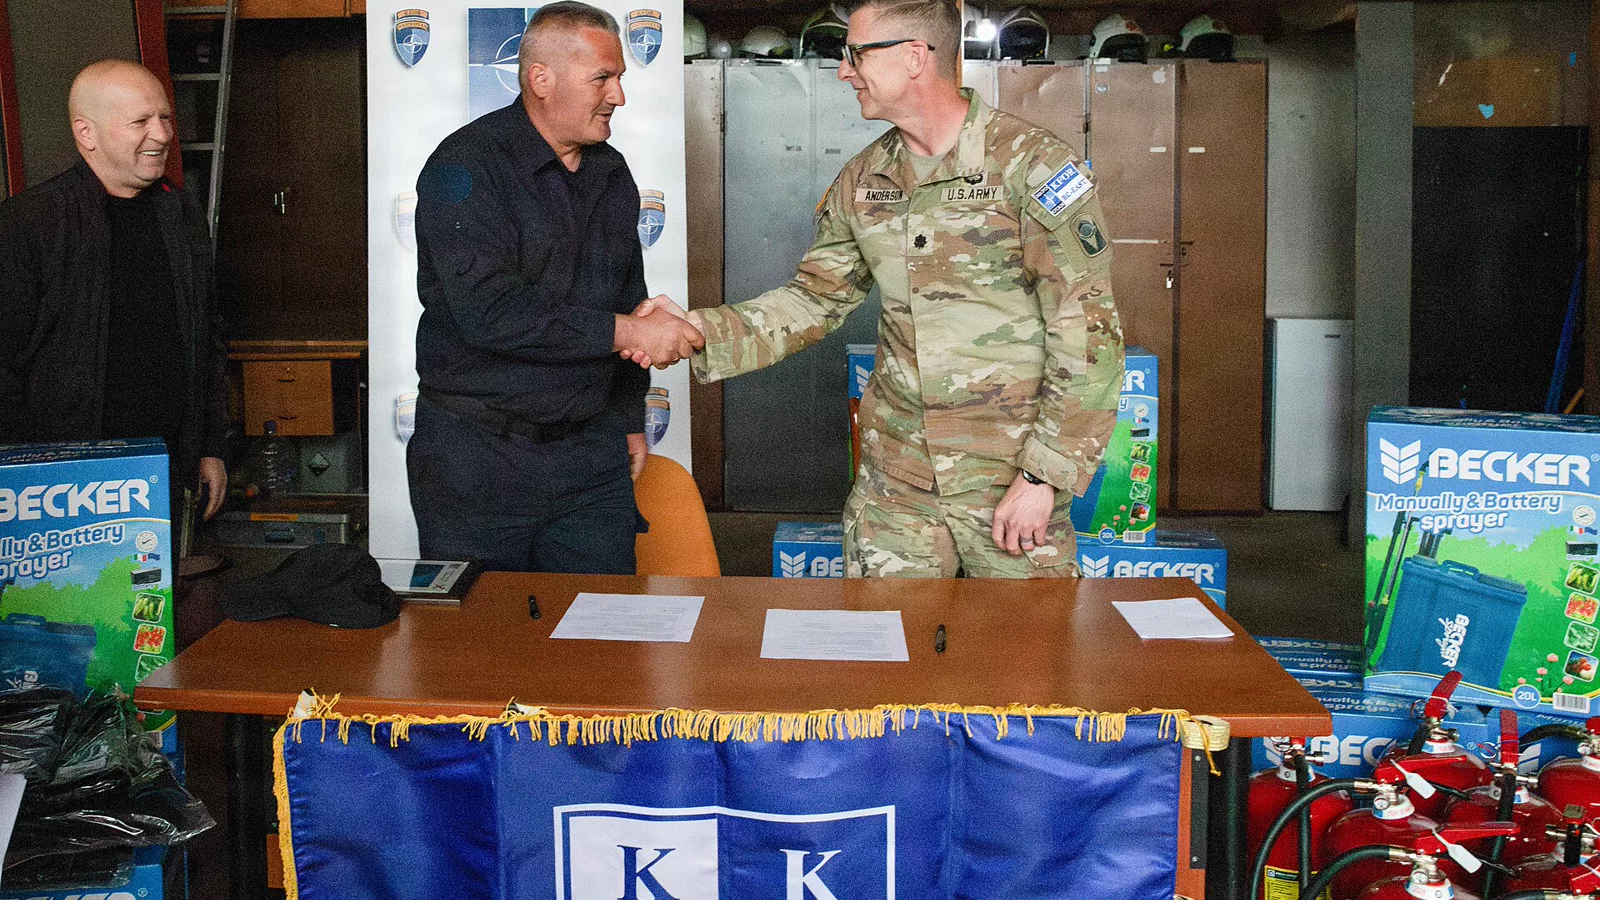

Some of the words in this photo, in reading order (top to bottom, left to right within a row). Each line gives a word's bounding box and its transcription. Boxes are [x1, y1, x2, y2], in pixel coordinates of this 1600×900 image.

[1050, 167, 1076, 190] KFOR
[865, 190, 904, 201] ANDERSON
[1428, 447, 1589, 487] BECKER
[0, 478, 150, 522] BECKER
[1420, 511, 1509, 534] sprayer
[0, 550, 73, 580] prayer
[1113, 560, 1215, 584] BECKER
[1442, 613, 1470, 668] BECKER
[1517, 690, 1538, 702] 20L
[1311, 734, 1394, 767] BEC
[616, 844, 681, 900] K
[779, 848, 842, 900] K
